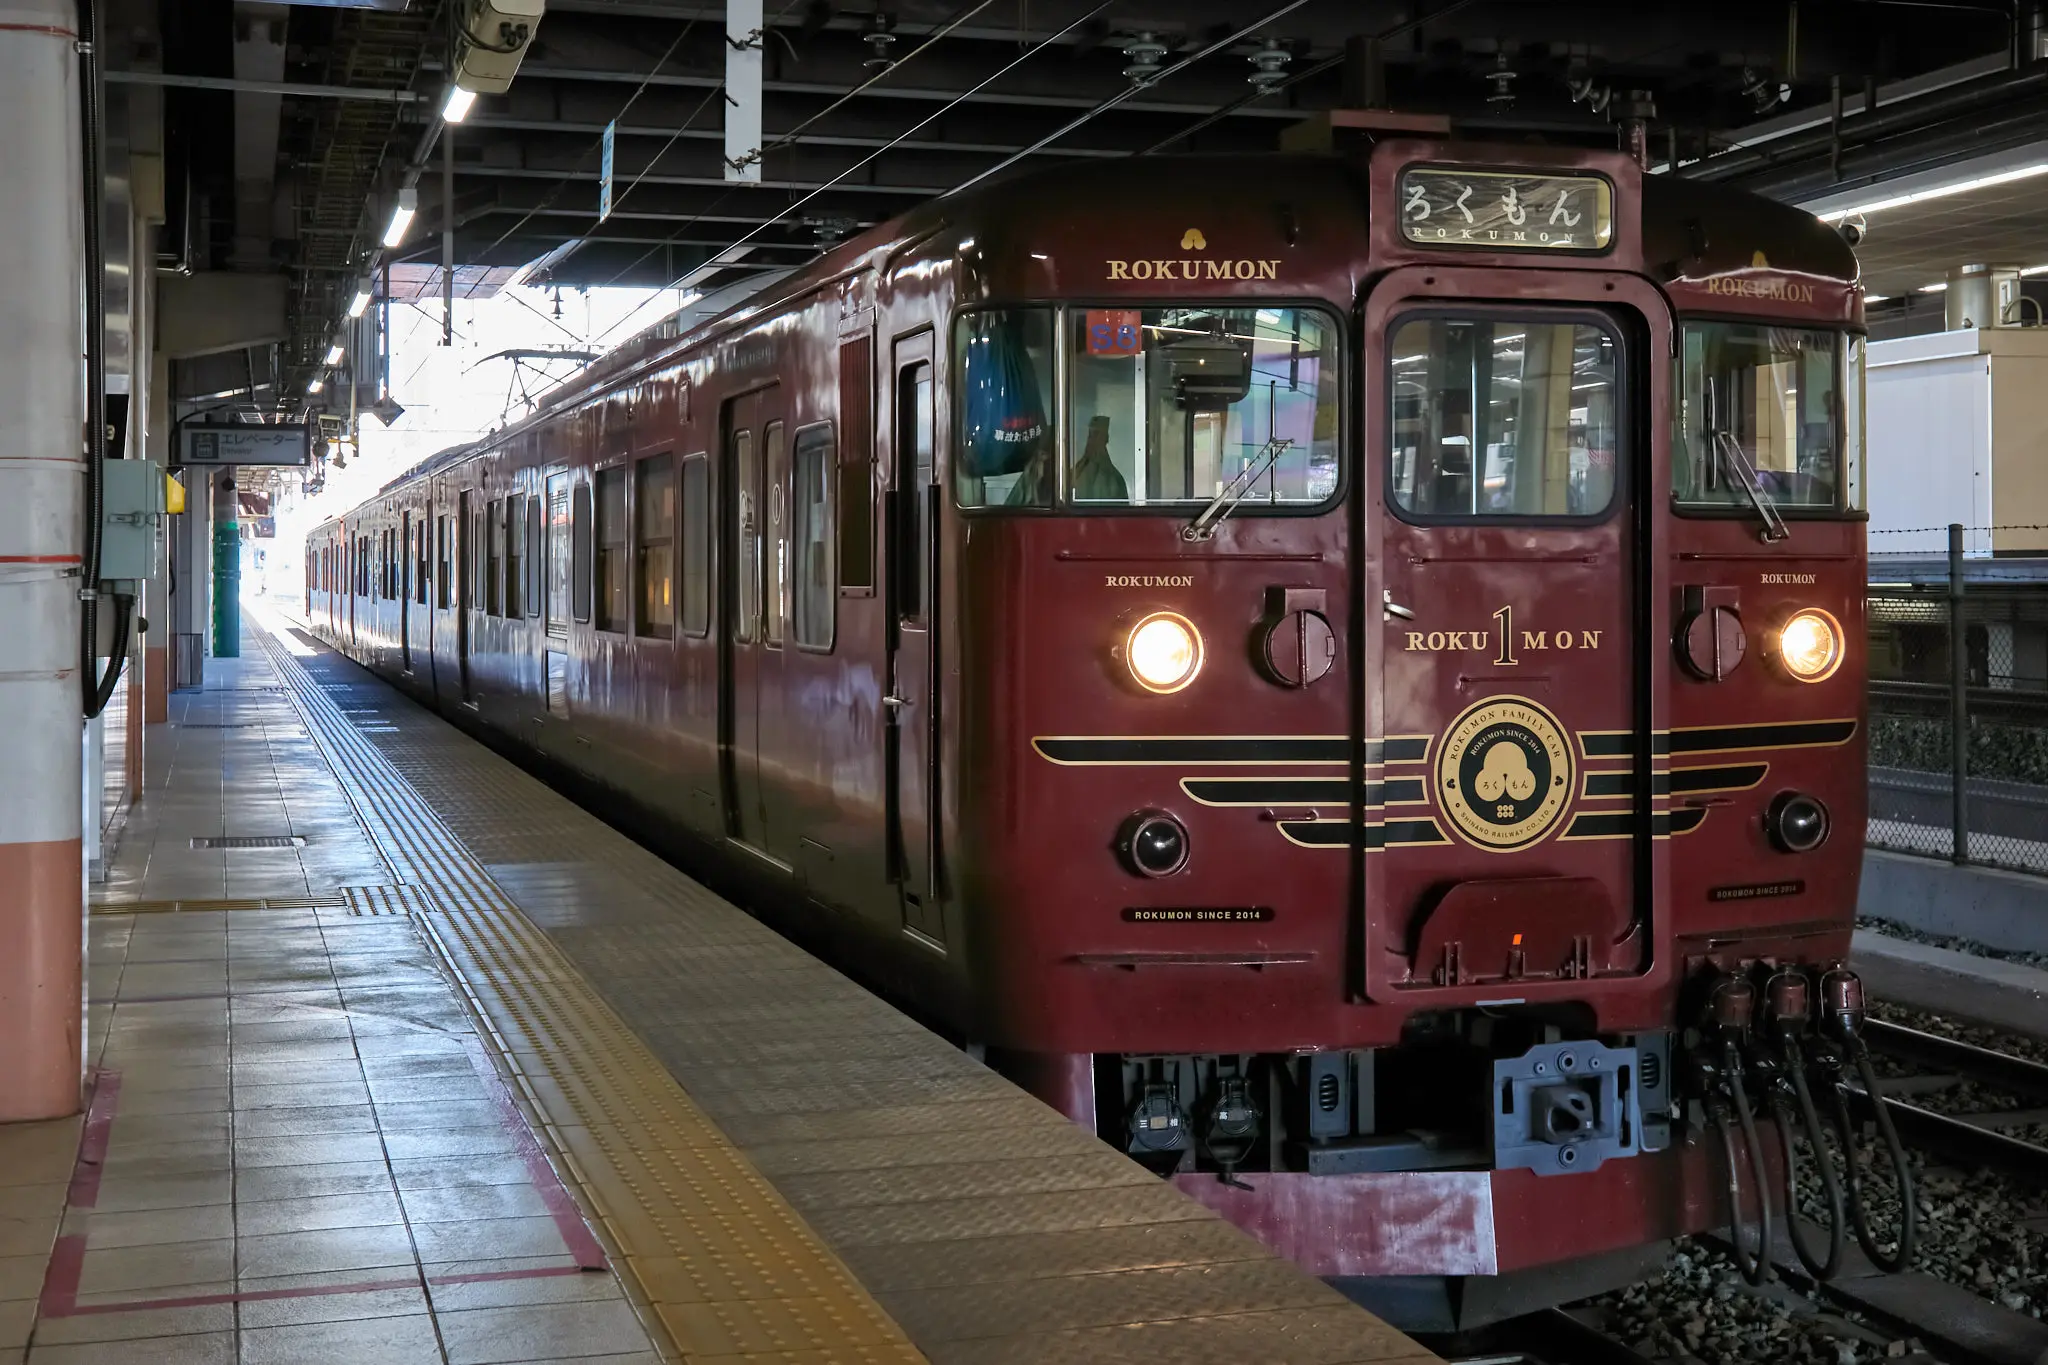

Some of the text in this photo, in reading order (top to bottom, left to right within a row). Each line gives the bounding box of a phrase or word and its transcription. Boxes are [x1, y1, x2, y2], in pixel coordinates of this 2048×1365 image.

[1405, 185, 1581, 227] ろくもん
[1413, 228, 1574, 242] ROKUMON
[1106, 260, 1281, 280] ROKUMON
[1708, 278, 1816, 302] ROKUMON
[1091, 323, 1137, 350] S8
[220, 433, 297, 446] エレベーター
[1105, 576, 1194, 587] ROKUMON
[1760, 573, 1816, 584] ROKUMON
[1404, 605, 1603, 665] ROKU 1 MON
[1451, 709, 1561, 760] ROKUMON FAMILY CAR
[1470, 730, 1541, 756] ROKUMON SINCE 2014
[1491, 828, 1524, 839] RAILWAY
[1135, 911, 1260, 920] ROKUMON SINCE 2014
